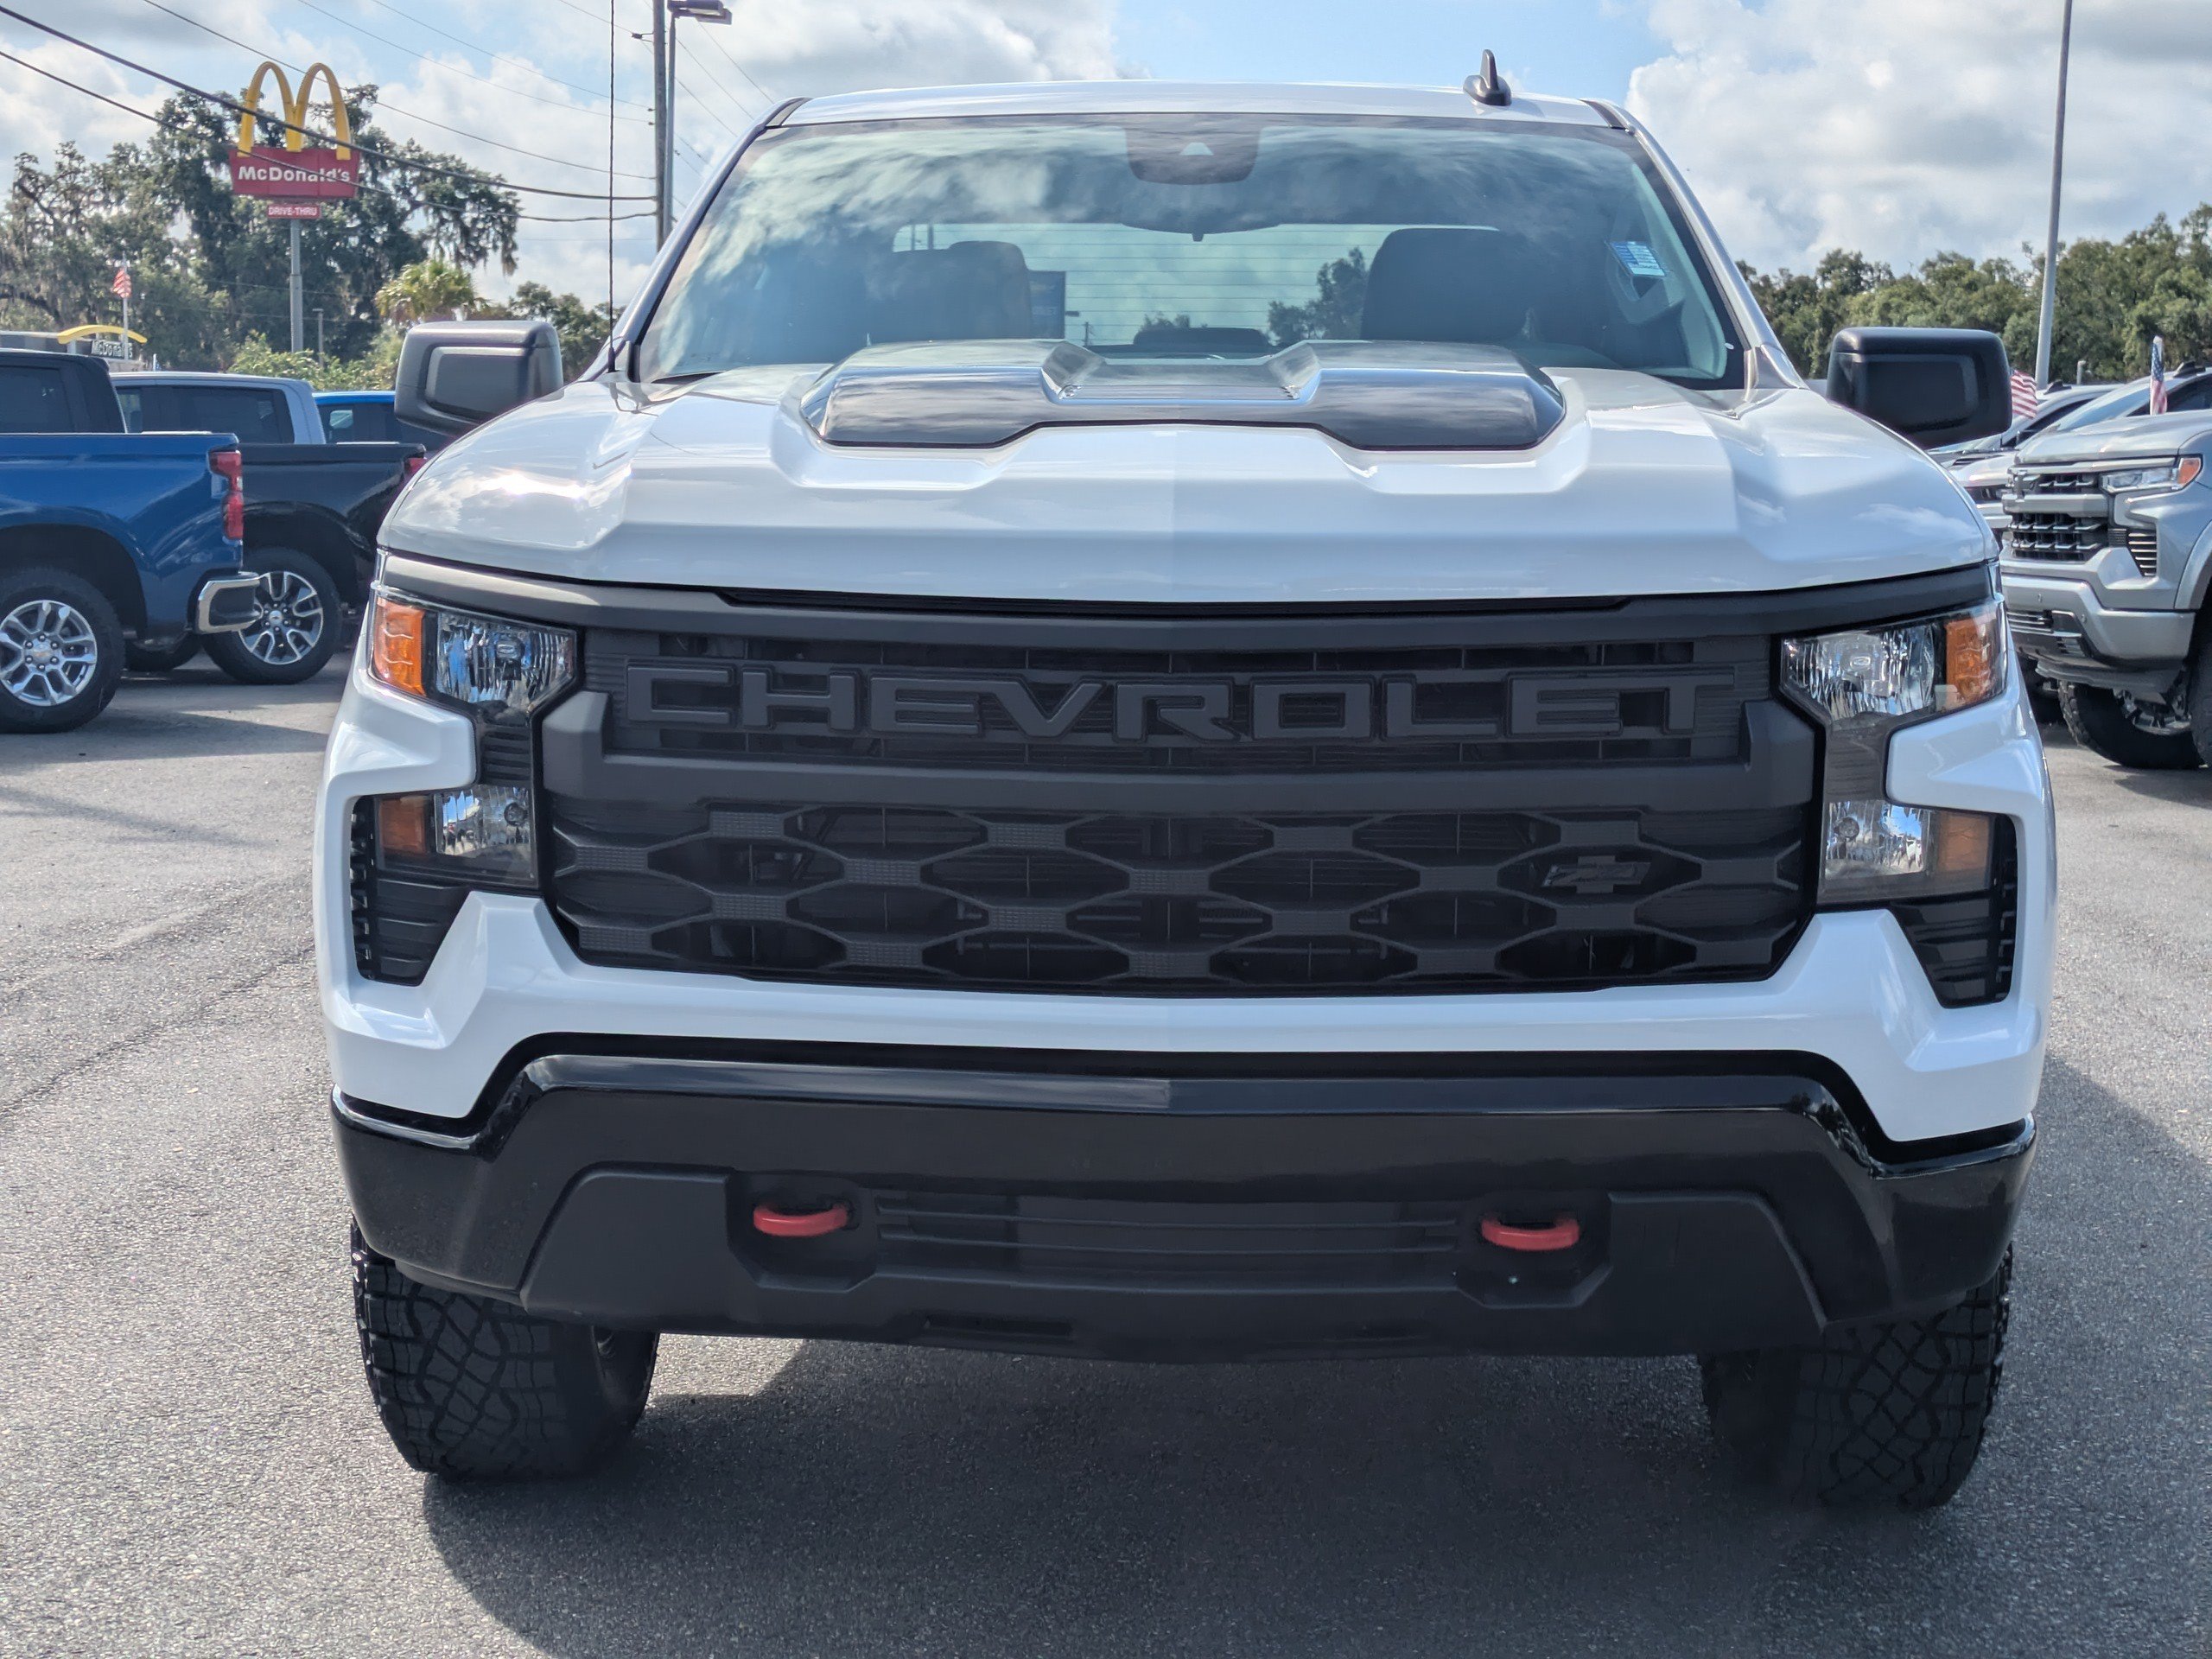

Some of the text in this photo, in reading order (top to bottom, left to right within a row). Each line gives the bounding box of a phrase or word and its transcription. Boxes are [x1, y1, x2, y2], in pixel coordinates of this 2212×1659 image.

[238, 165, 351, 182] McDonald's
[268, 206, 318, 216] DRIVE-THRU
[626, 664, 1735, 742] CHEVROLET
